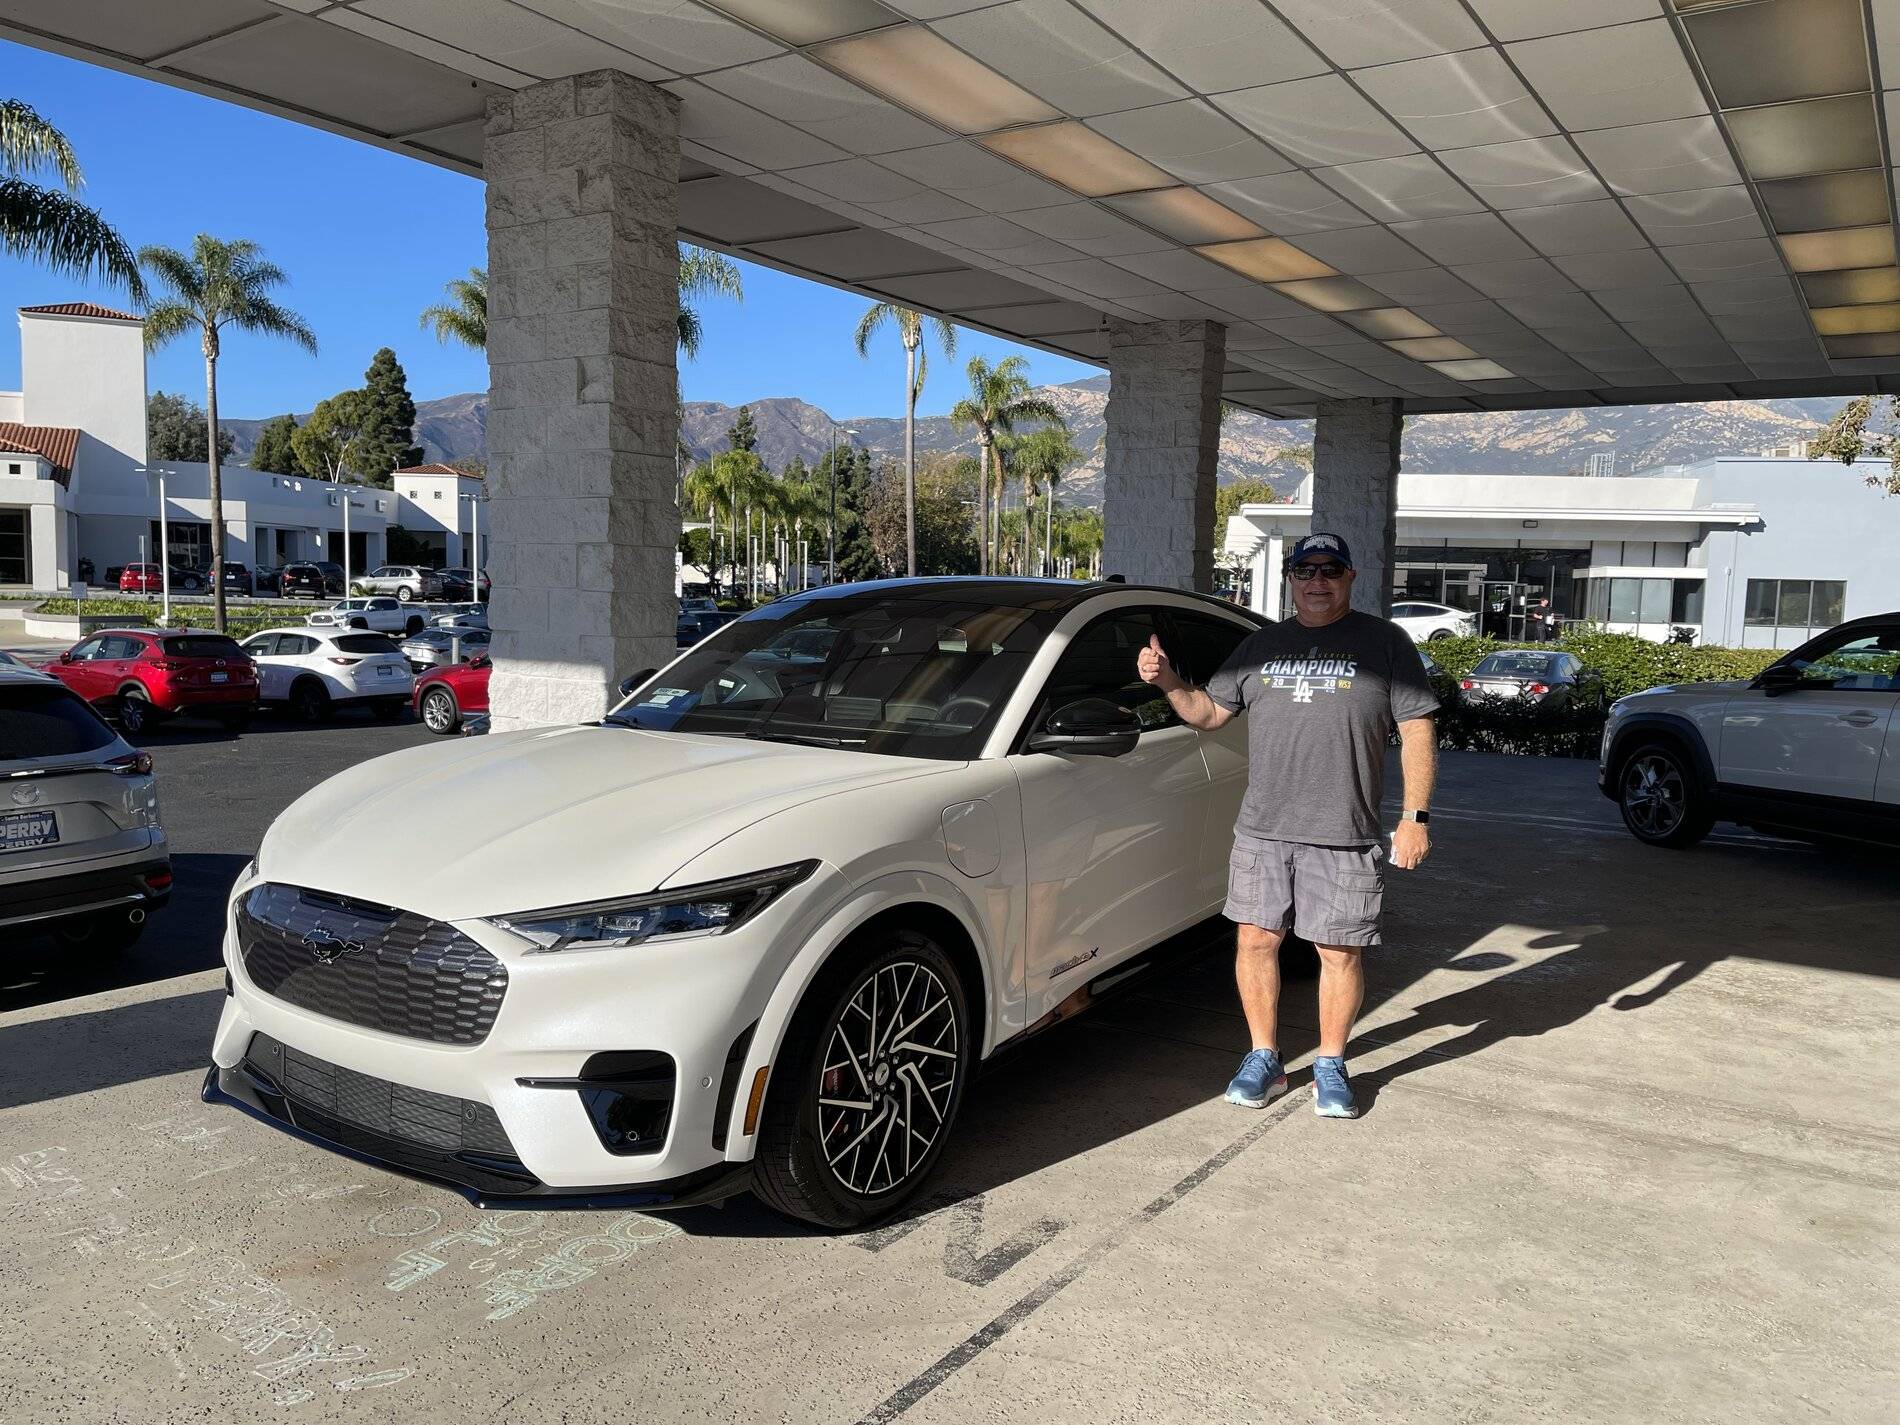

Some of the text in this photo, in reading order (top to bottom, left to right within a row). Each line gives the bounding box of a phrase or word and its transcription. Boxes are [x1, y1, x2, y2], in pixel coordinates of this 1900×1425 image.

[1260, 659, 1358, 677] CHAMPIONS
[1272, 678, 1284, 686] 20
[1292, 675, 1313, 703] LA
[1324, 679, 1336, 687] 20
